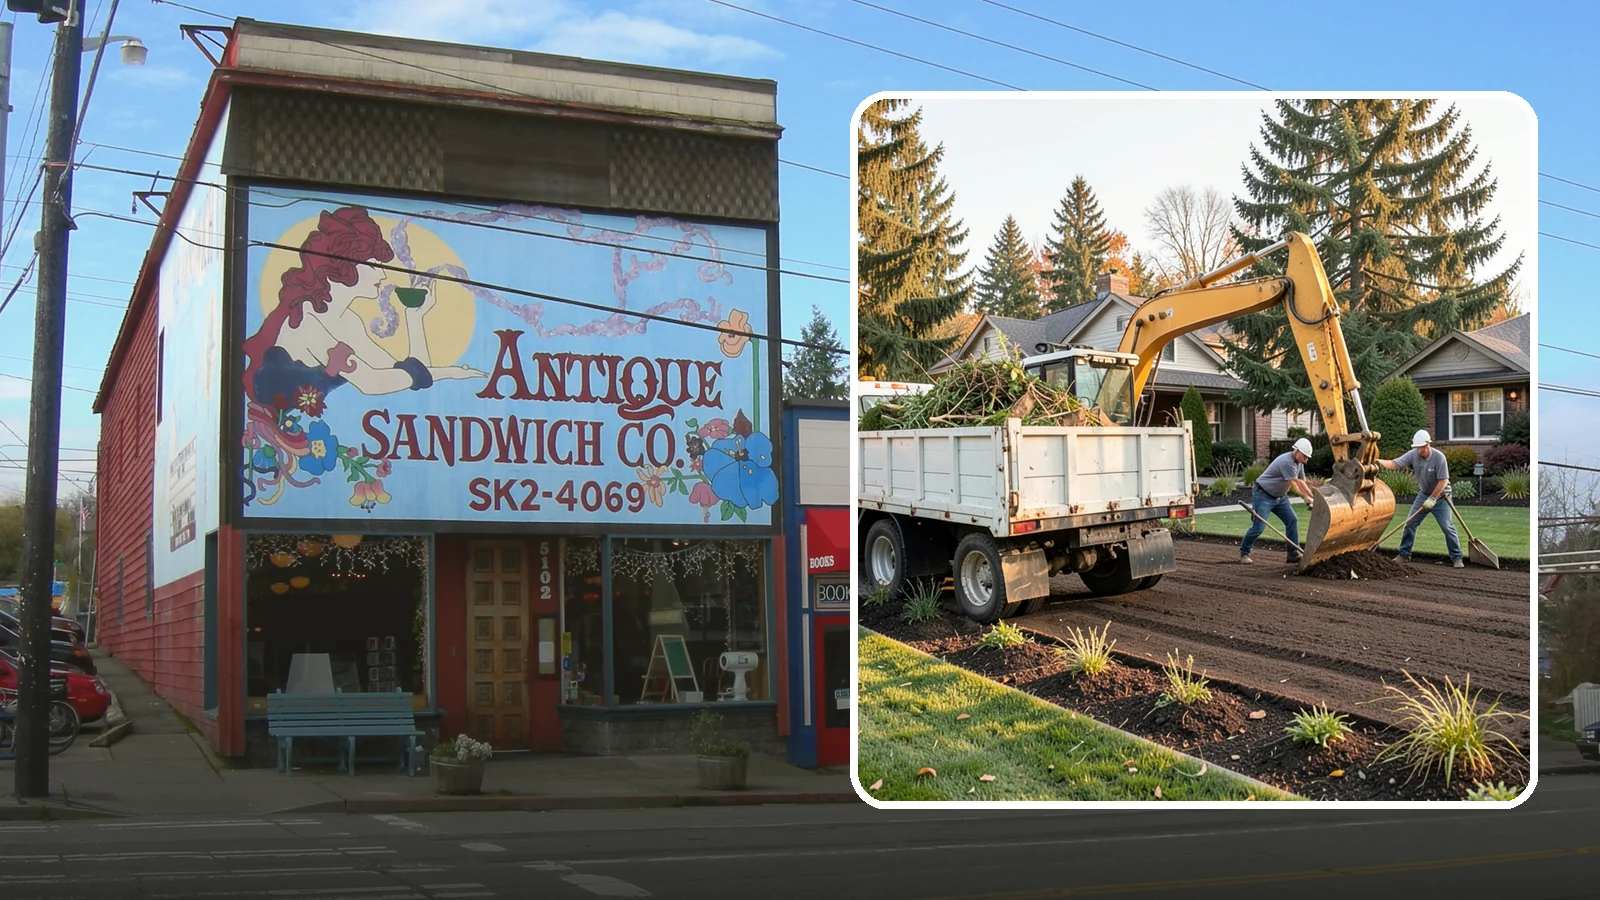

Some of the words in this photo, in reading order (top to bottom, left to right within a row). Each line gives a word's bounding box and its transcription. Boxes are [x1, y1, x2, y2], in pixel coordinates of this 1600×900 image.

[476, 329, 723, 420] ANTIQUE
[361, 408, 604, 467] SANDWICH
[617, 422, 684, 468] CO.
[469, 477, 645, 513] SK2-4069
[540, 541, 551, 600] 5102
[809, 555, 835, 569] BOOKS
